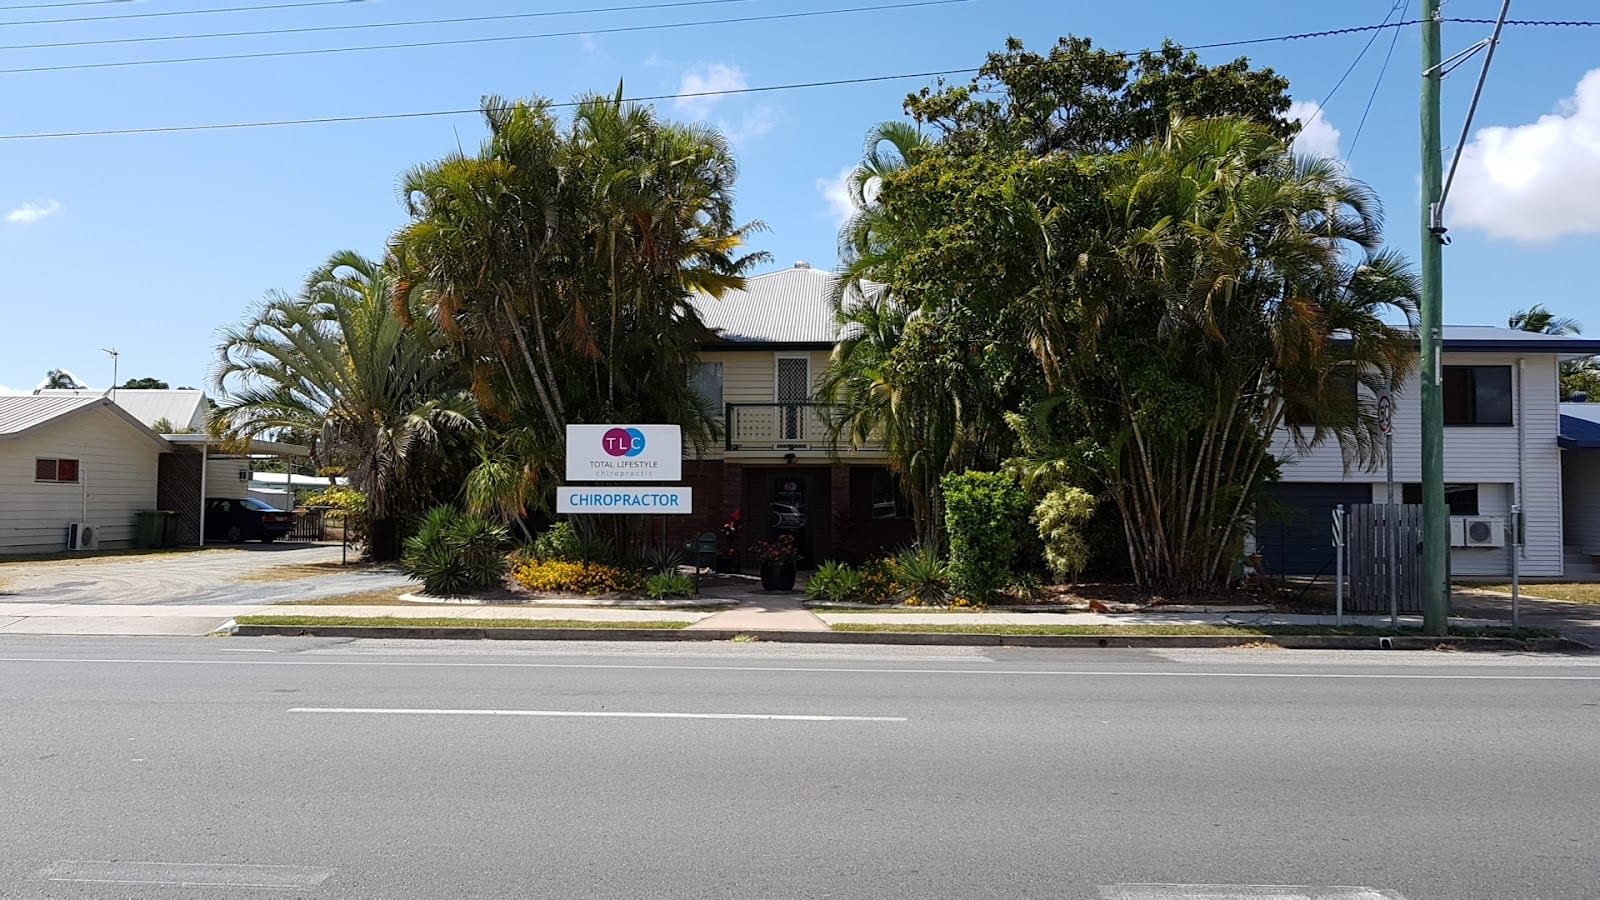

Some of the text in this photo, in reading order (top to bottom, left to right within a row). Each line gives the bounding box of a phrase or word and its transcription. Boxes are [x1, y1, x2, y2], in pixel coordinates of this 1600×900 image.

[606, 437, 641, 450] TLC
[595, 469, 654, 477] chiropractic
[570, 494, 679, 506] CHIROPRACTOR
